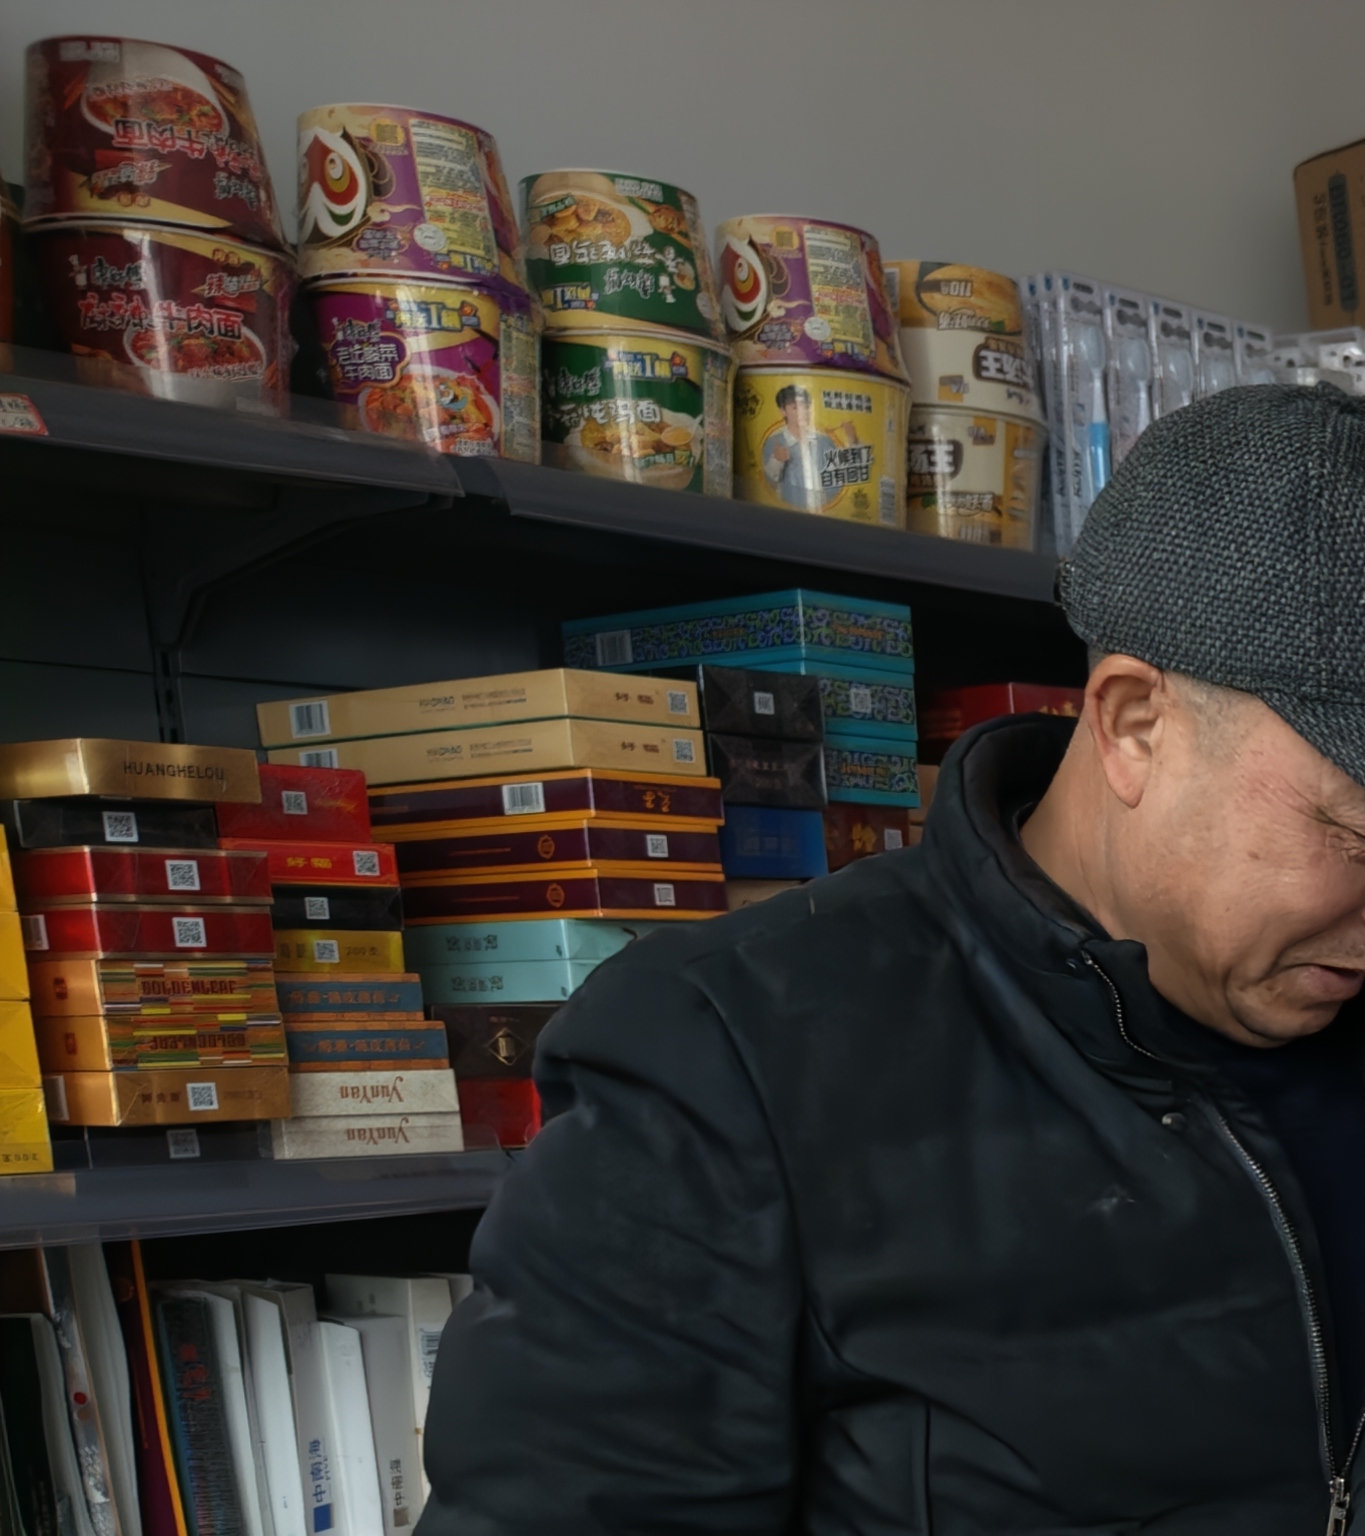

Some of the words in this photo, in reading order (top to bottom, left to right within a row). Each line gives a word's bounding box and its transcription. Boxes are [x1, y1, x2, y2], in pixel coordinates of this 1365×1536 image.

[124, 760, 225, 781] HUANGHELOU
[340, 1076, 404, 1103] YunYan
[346, 1117, 410, 1145] YunYan
[307, 1438, 323, 1503] 中南海
[389, 1459, 405, 1506] 中南海
